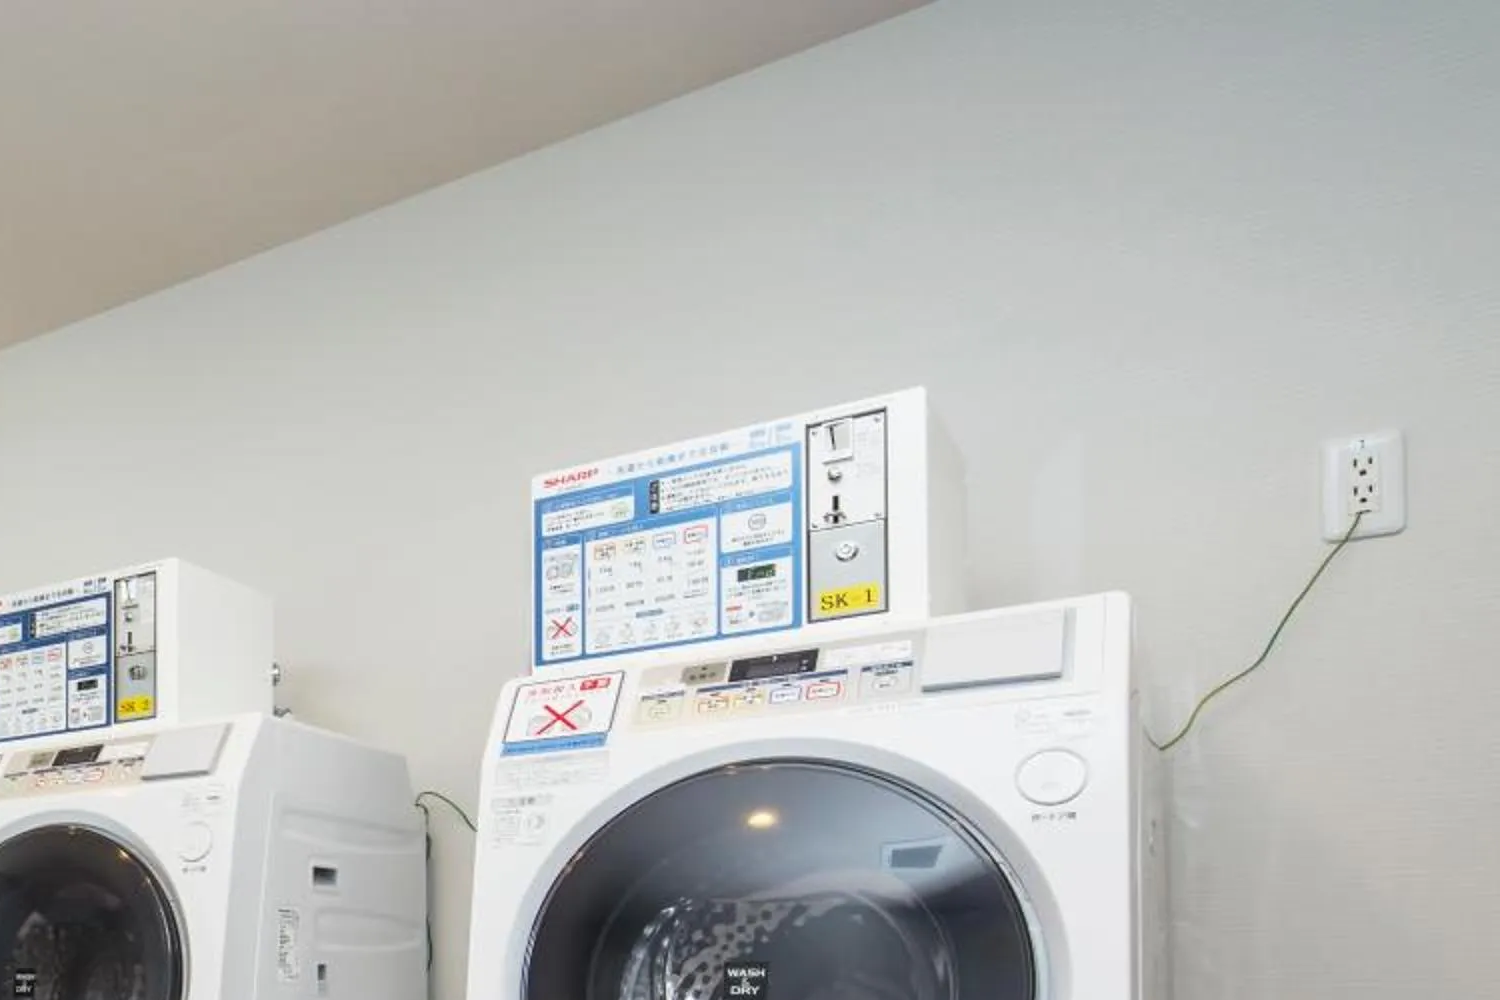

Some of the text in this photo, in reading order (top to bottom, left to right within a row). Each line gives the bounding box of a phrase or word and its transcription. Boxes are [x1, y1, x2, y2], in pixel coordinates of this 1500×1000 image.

[543, 467, 599, 489] SHARP
[821, 588, 877, 611] SK 1
[727, 968, 765, 977] WASH
[730, 985, 760, 995] DRY
